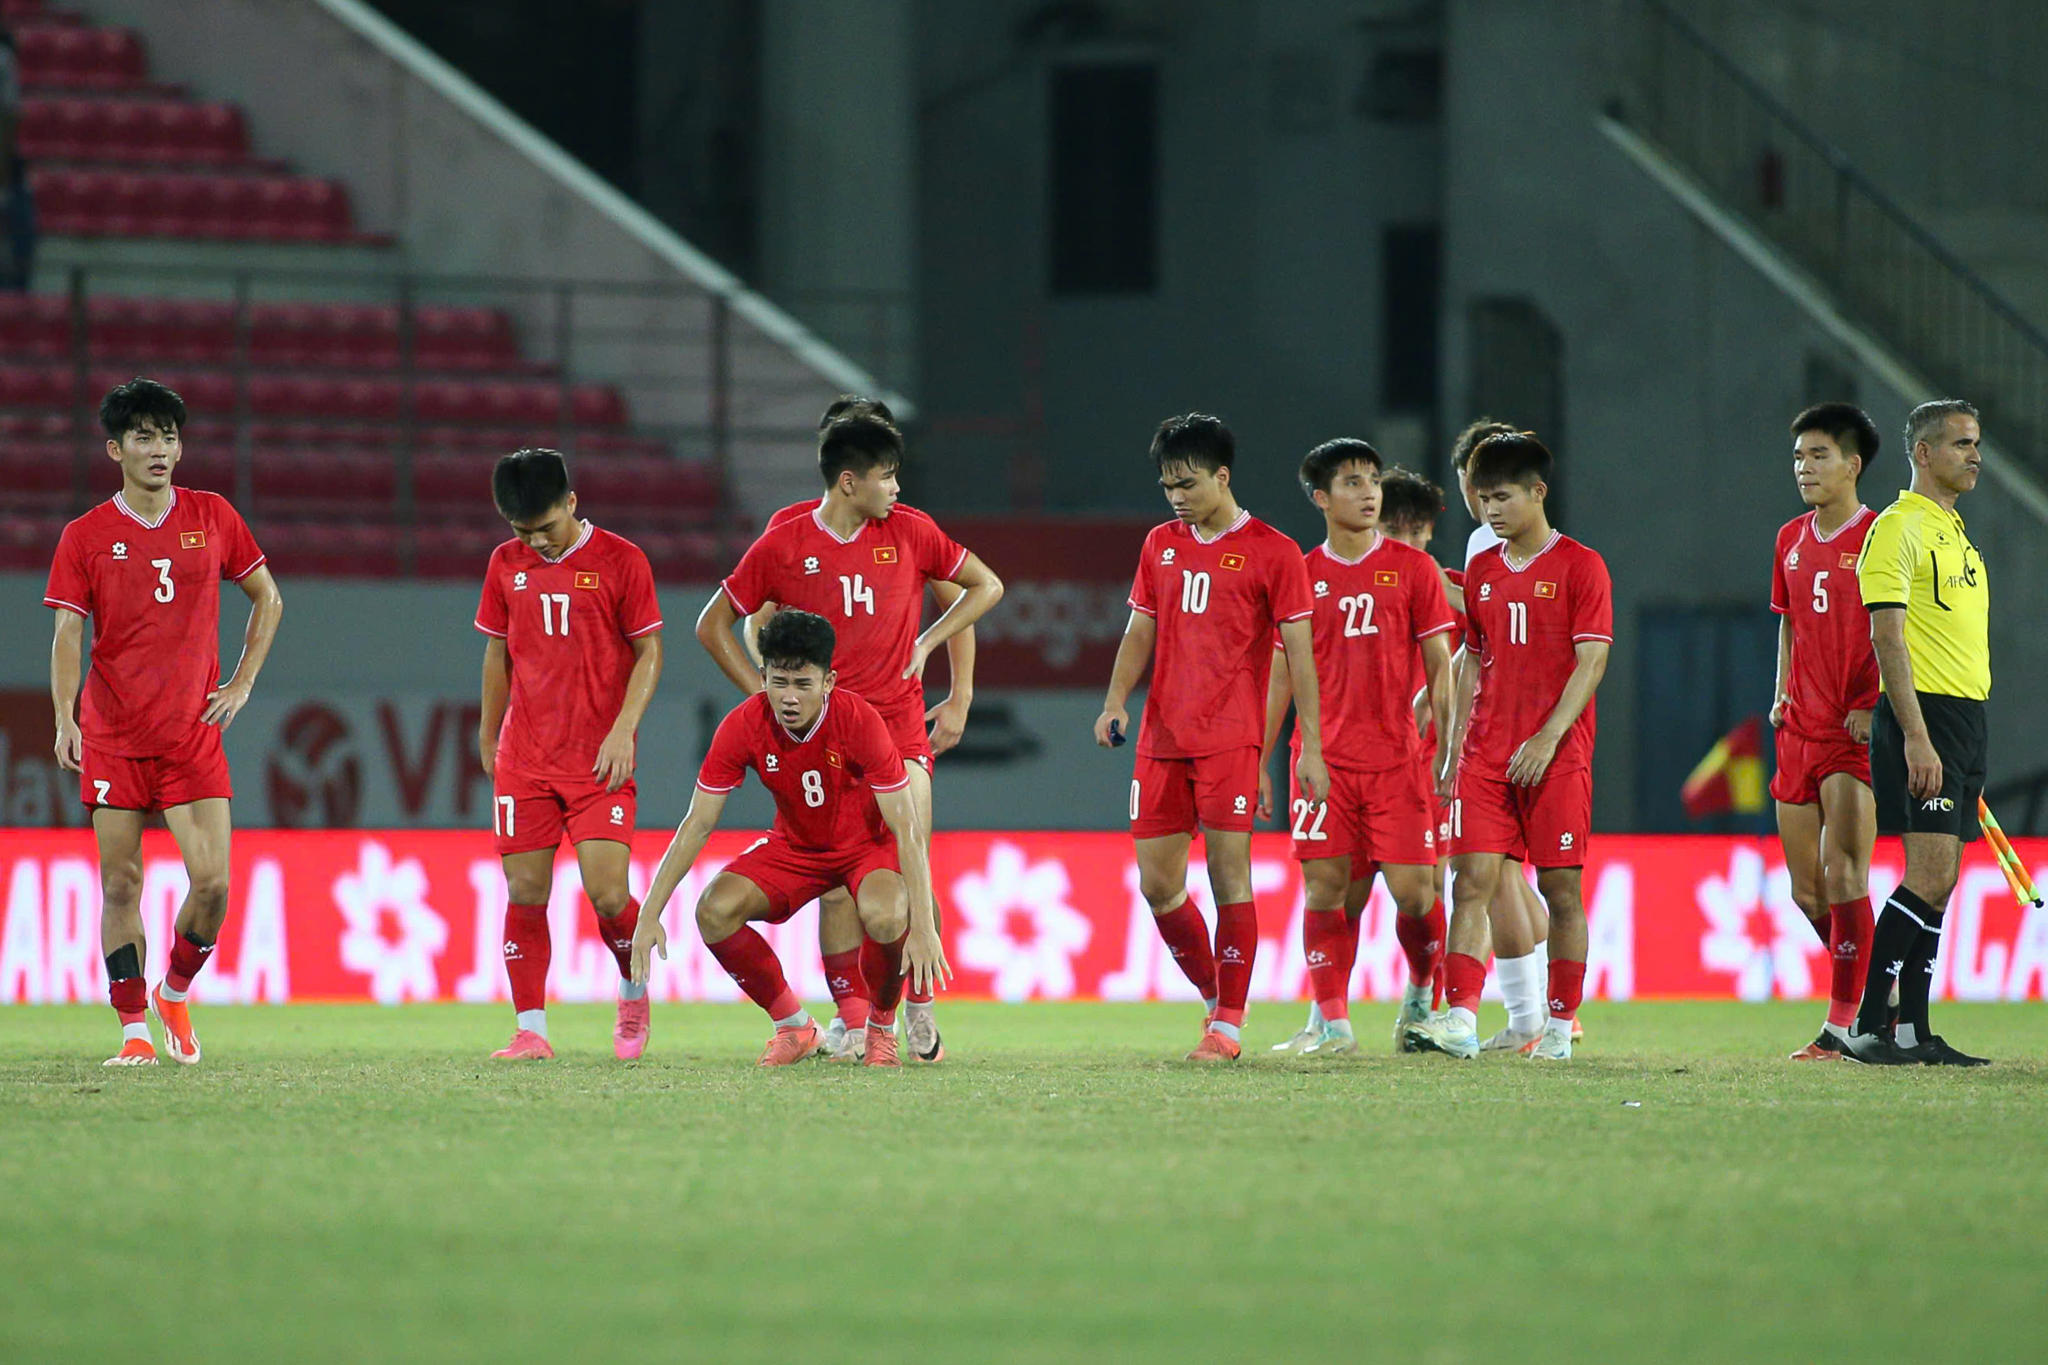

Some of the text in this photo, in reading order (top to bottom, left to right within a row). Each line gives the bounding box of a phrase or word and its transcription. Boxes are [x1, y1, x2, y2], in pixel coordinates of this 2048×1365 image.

[151, 558, 175, 603] 3
[839, 573, 875, 617] 14
[1181, 569, 1211, 614] 10
[1812, 571, 1829, 613] 5
[540, 593, 570, 636] 17
[1338, 593, 1379, 638] 22
[1507, 602, 1527, 645] 11
[801, 769, 825, 808] 8
[1921, 797, 1954, 811] AFC
[1291, 798, 1328, 840] 22
